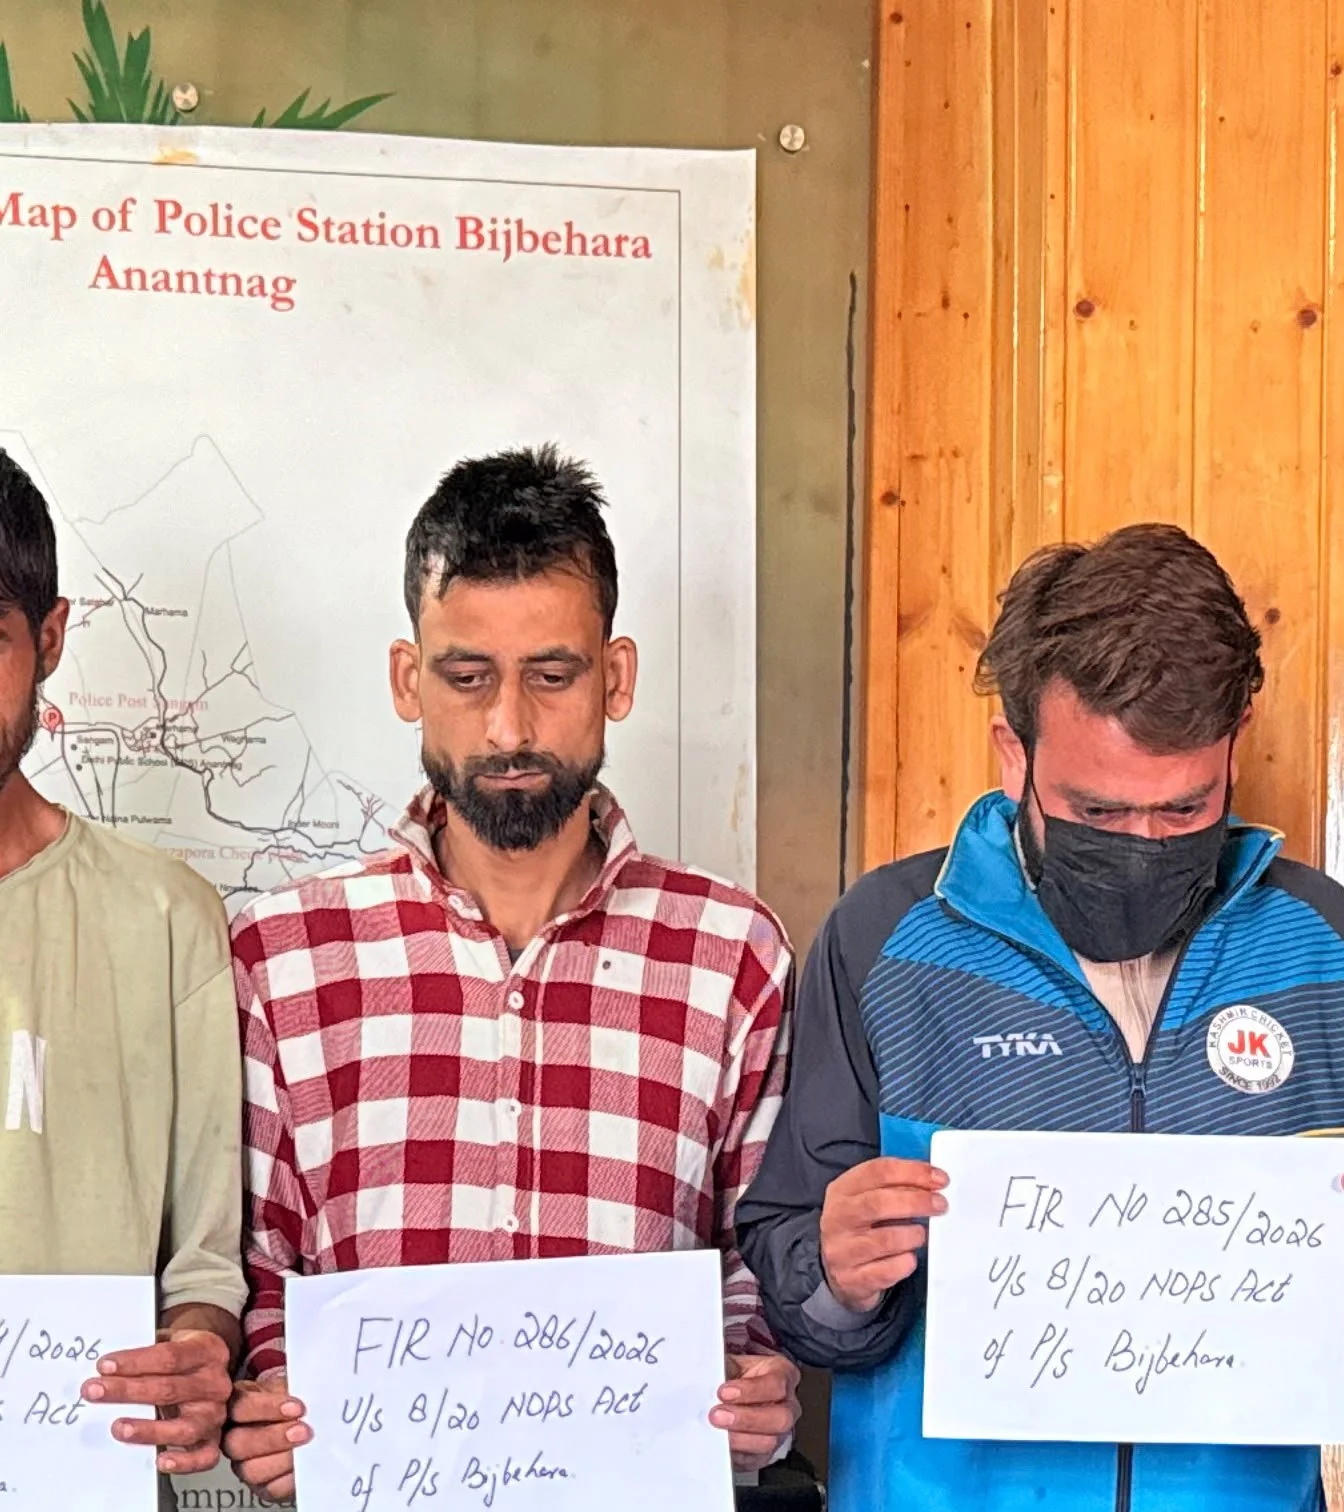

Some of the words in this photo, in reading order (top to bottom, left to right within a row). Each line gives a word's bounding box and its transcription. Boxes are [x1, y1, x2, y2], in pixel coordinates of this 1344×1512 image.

[91, 196, 137, 233] of
[154, 198, 282, 241] Police
[295, 206, 441, 250] Station
[455, 214, 653, 263] Bijbehara
[88, 254, 297, 313] Anantnag
[1227, 1029, 1273, 1059] JK
[999, 1175, 1065, 1233] FIR
[1161, 1189, 1324, 1251] 285/2026
[1045, 1255, 1126, 1310] 8/20
[1229, 1268, 1295, 1304] Act
[353, 1316, 431, 1376] FIR
[23, 1391, 84, 1426] Act
[591, 1382, 649, 1415] Act
